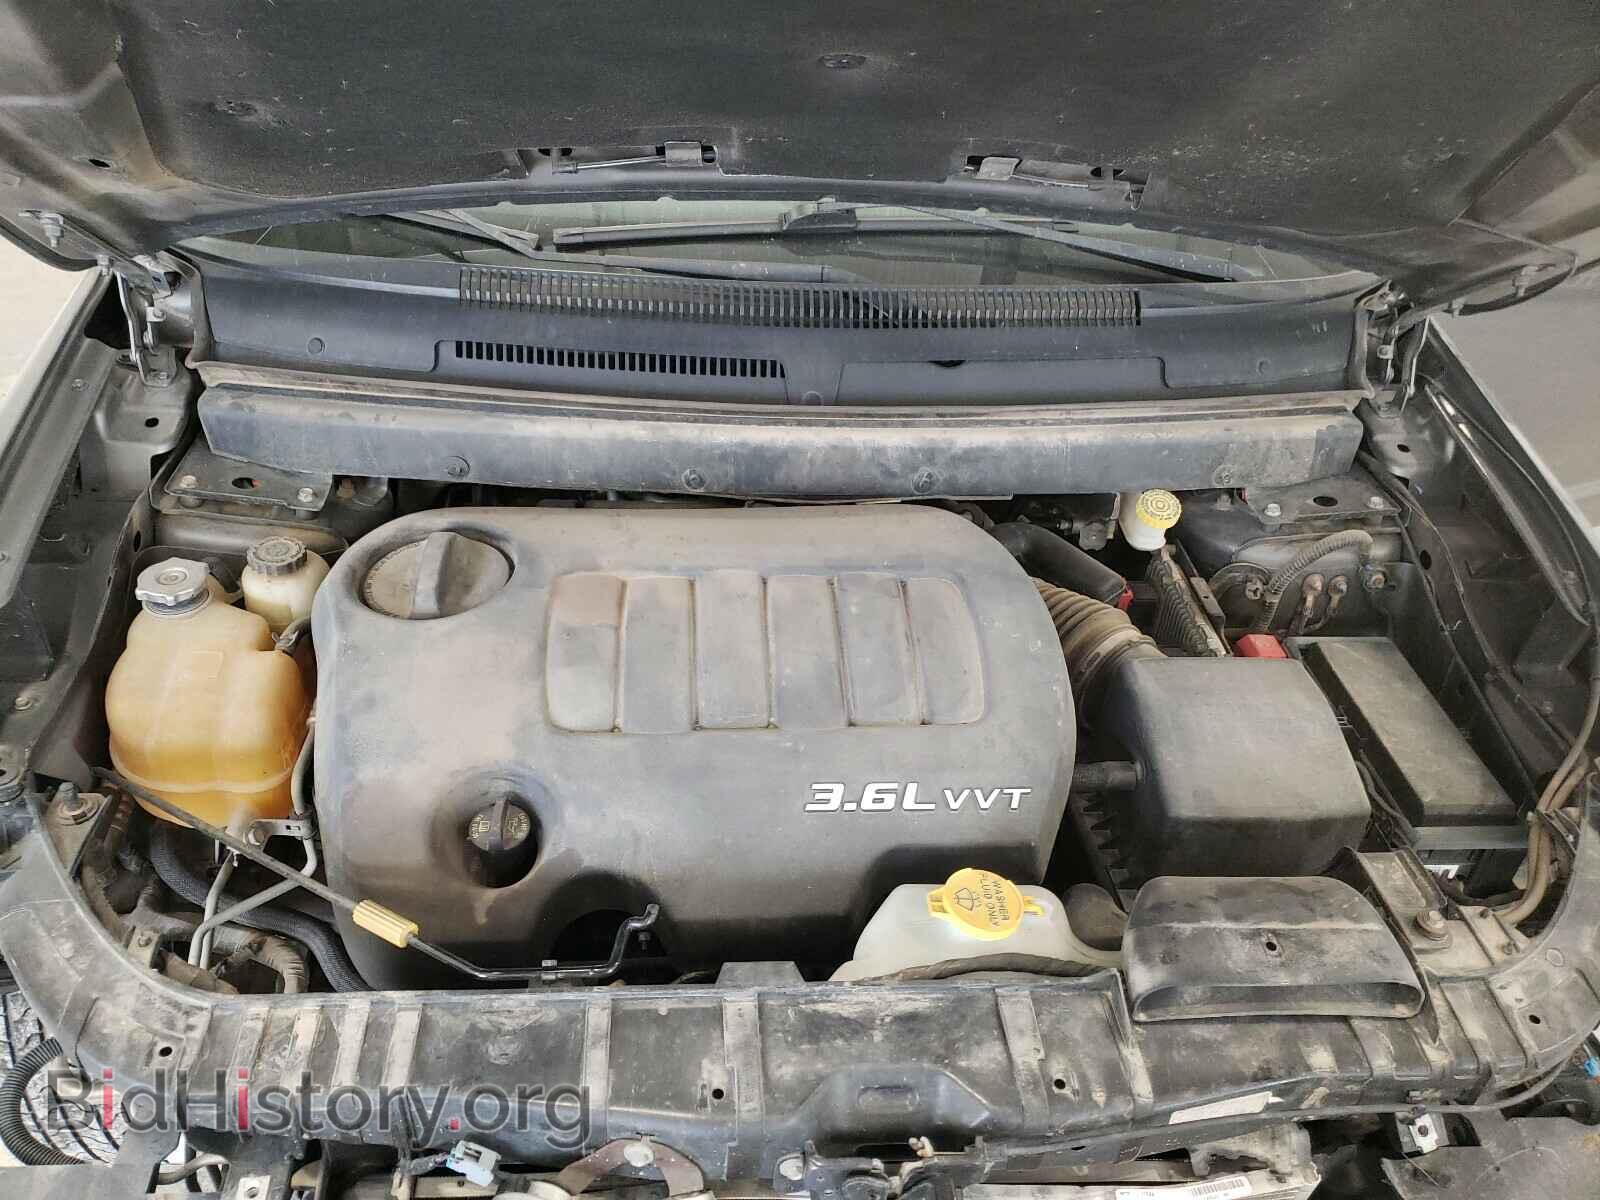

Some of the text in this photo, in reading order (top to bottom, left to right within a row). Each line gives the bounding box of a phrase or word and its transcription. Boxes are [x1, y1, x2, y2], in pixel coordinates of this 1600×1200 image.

[804, 782, 1031, 812] 3.6L VVT
[978, 873, 1001, 927] FLUID ONLY
[991, 880, 1010, 921] WASHER
